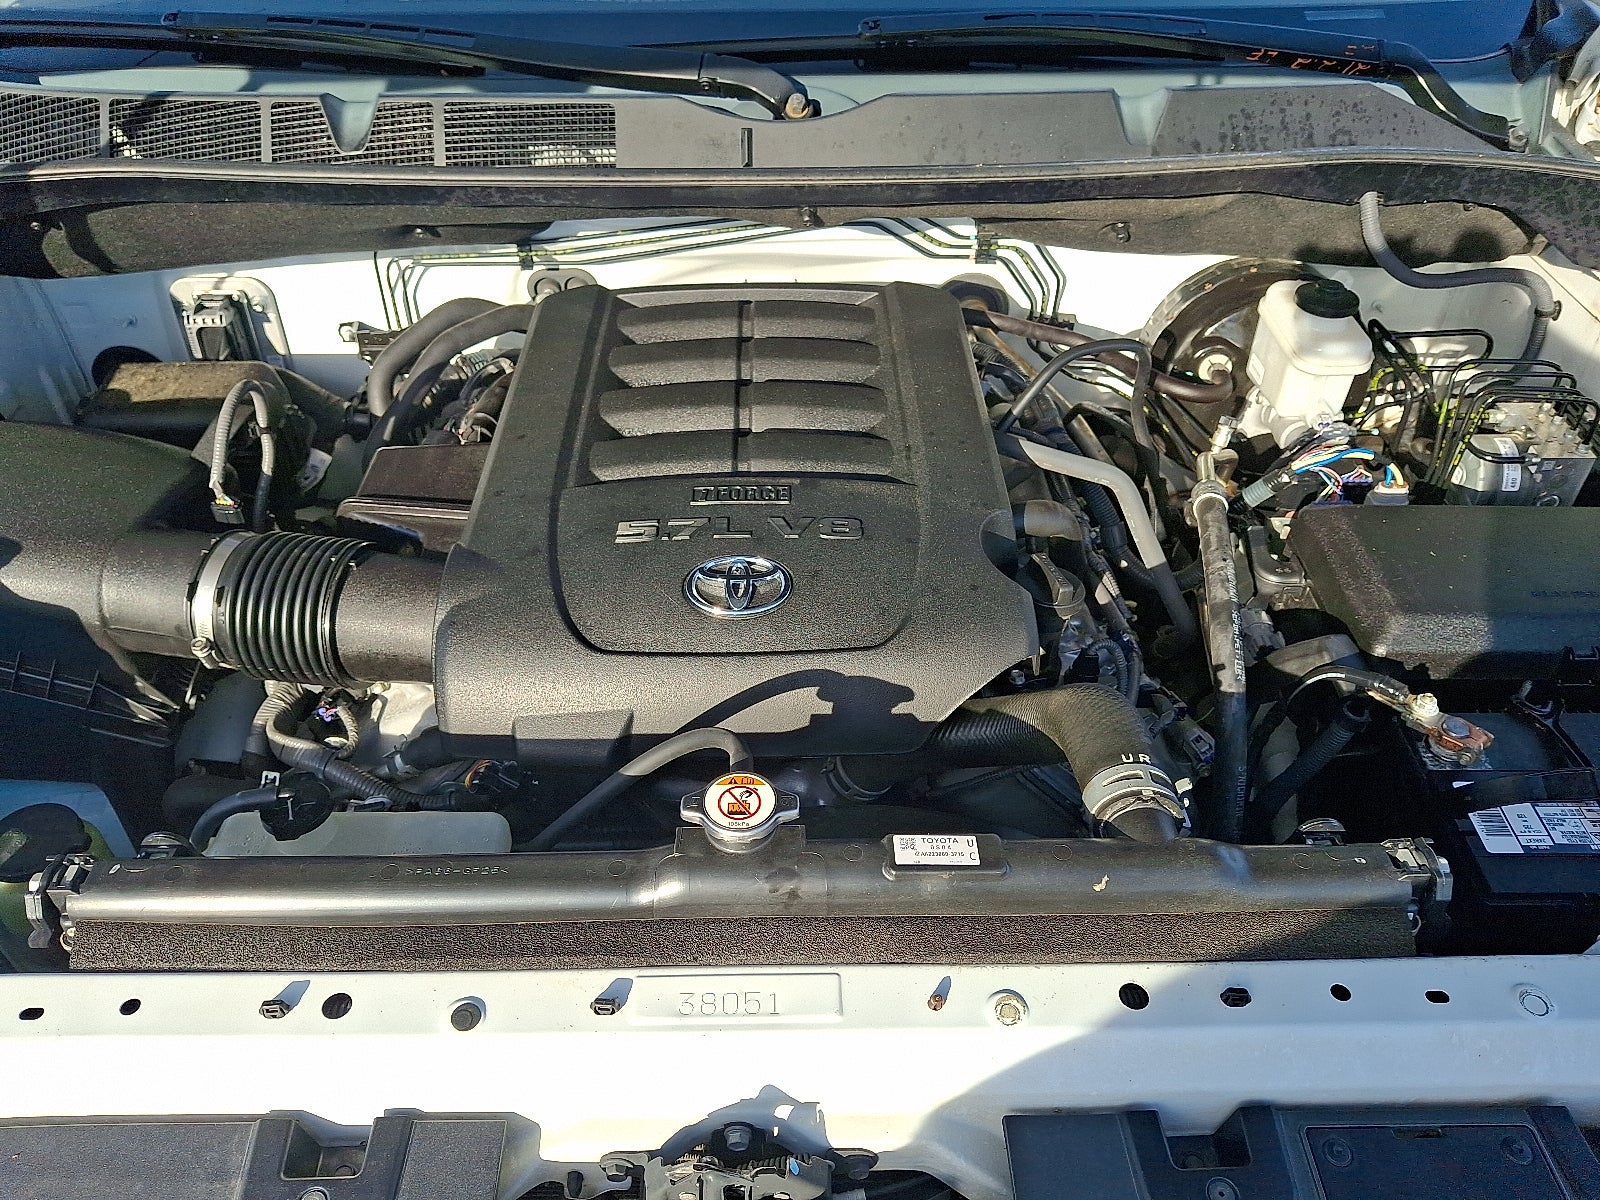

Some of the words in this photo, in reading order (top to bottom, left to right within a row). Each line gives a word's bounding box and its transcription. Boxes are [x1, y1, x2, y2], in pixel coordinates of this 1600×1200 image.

[613, 516, 752, 544] 5.7L
[768, 516, 864, 540] V8
[678, 991, 780, 1016] 38051
